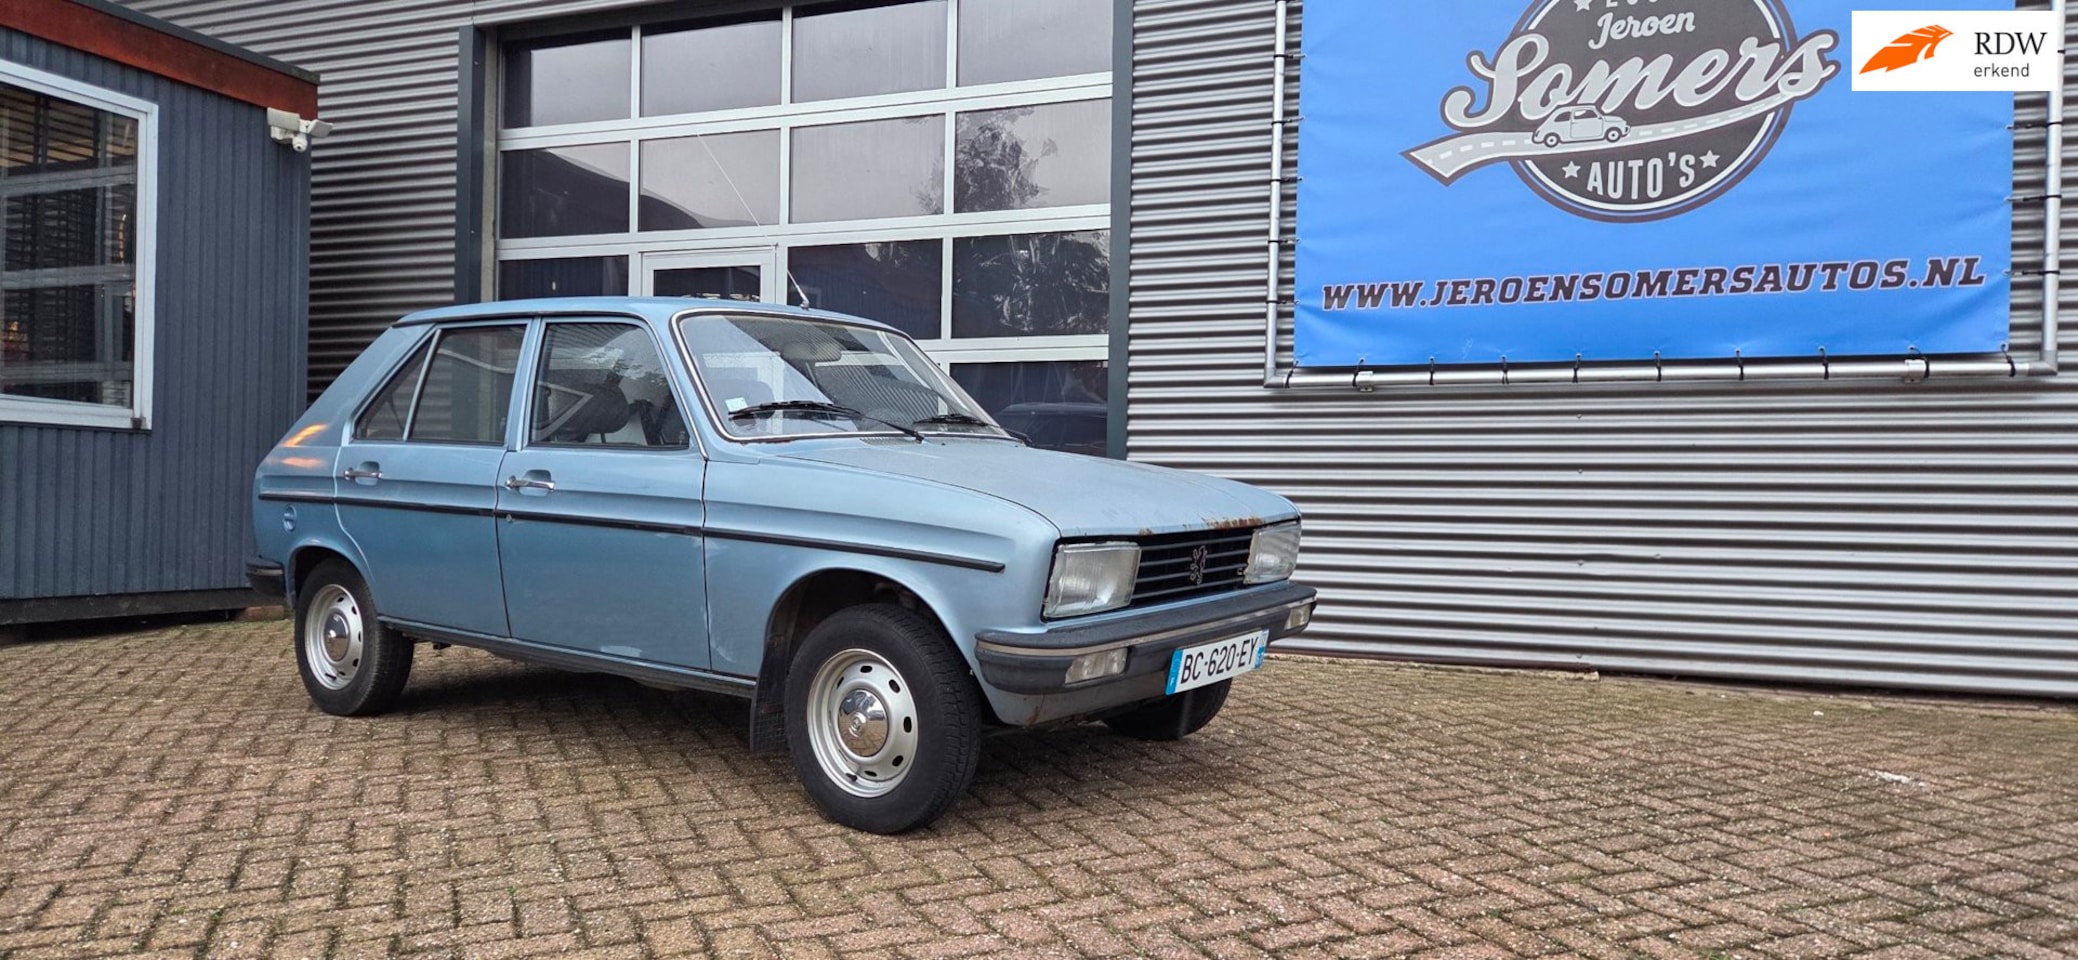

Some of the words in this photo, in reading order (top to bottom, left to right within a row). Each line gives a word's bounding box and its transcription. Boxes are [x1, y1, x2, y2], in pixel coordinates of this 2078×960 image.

[1588, 12, 1696, 49] Jeroen
[1444, 33, 1840, 128] Somers
[1586, 151, 1696, 200] AUTO'S
[1322, 256, 1986, 311] WWW.JEROENSOMERSAUTOS.NL
